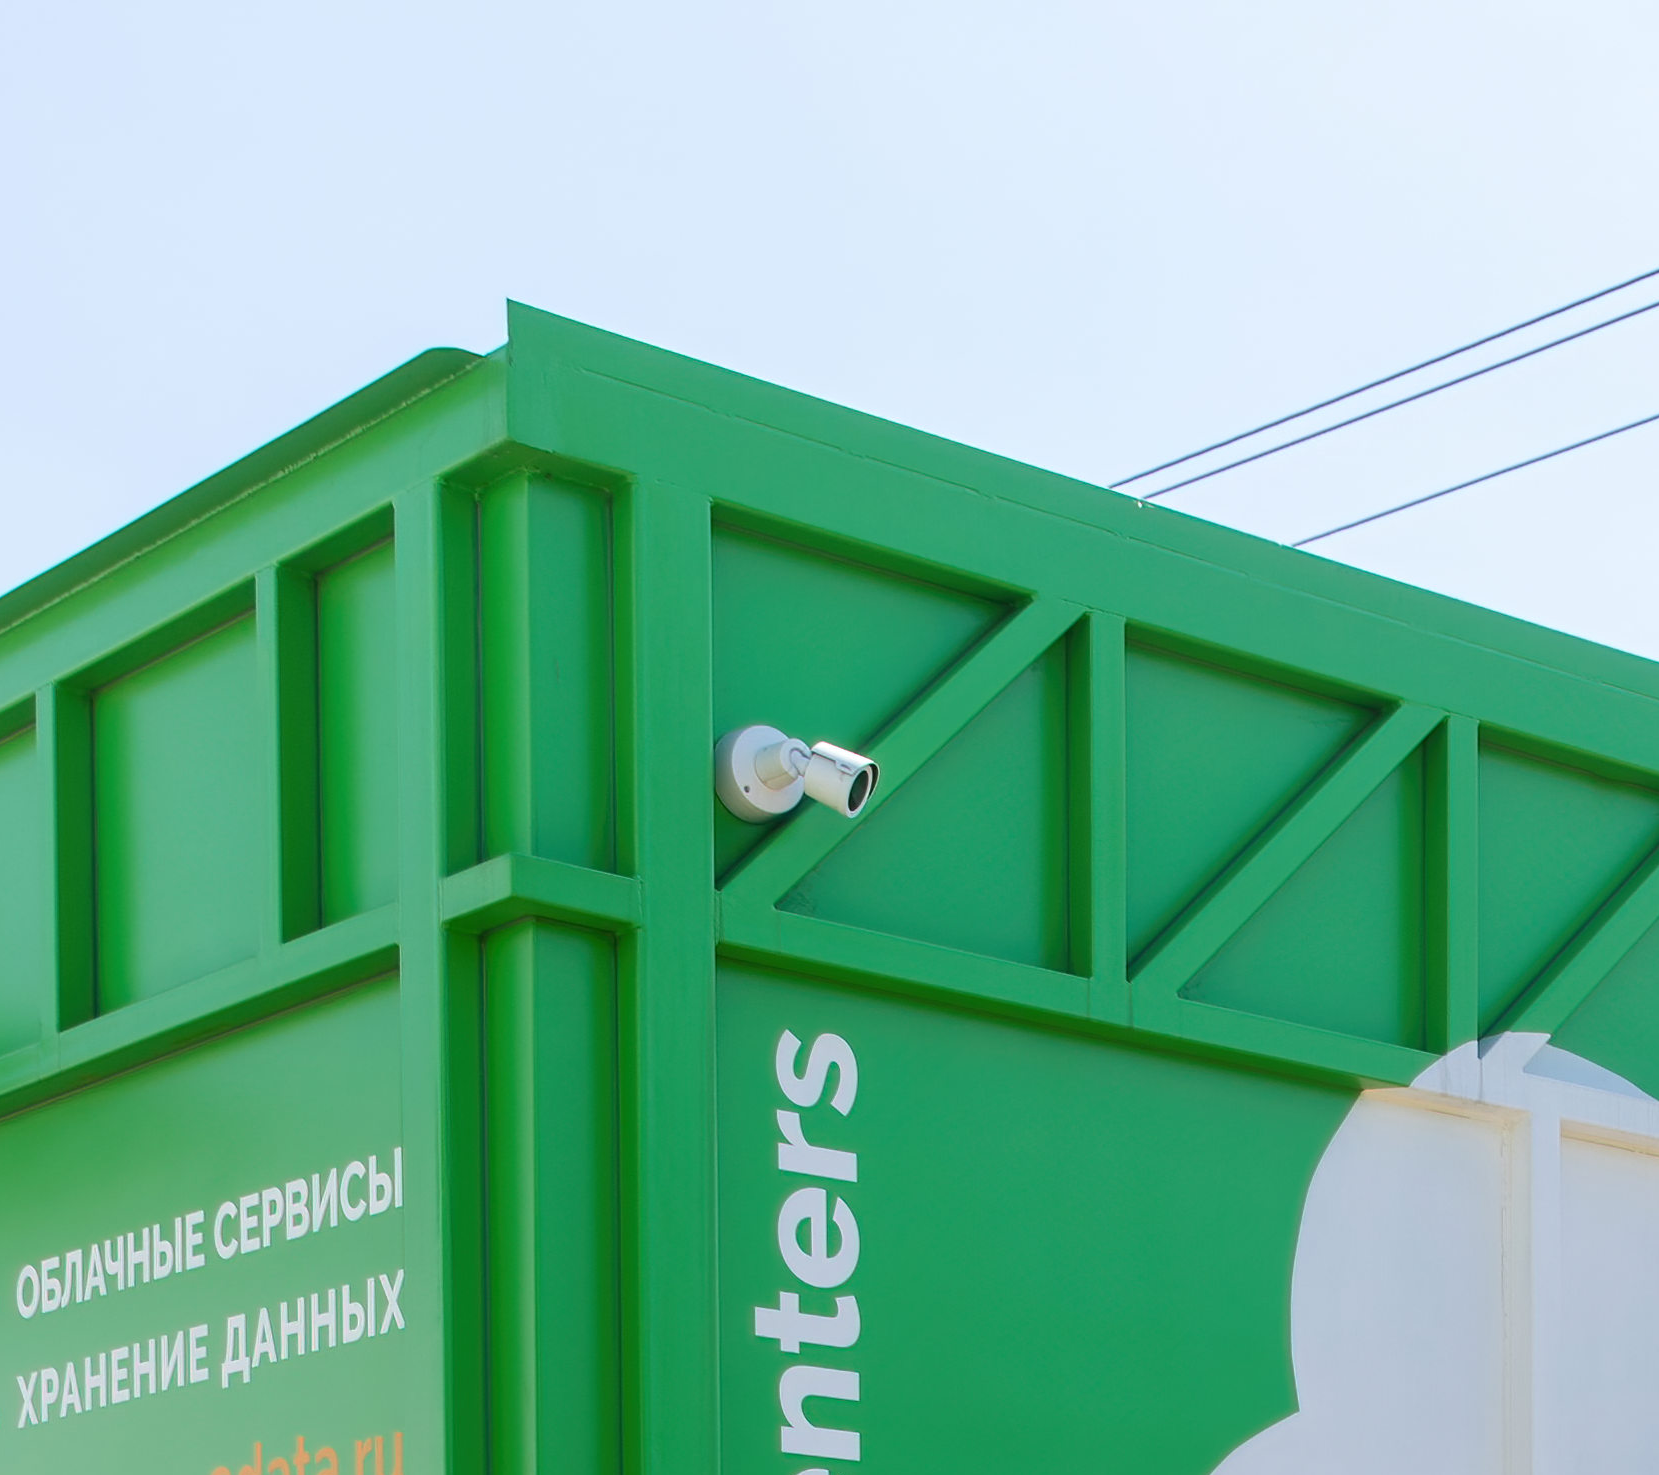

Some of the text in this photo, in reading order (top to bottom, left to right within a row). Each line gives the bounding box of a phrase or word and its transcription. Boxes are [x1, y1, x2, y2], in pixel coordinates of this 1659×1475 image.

[15, 1146, 405, 1321] ОБЛАЧНЫЕ СЕРВИСЫ
[16, 1268, 407, 1430] ХРАНЕНИЕ ДАННЫХ
